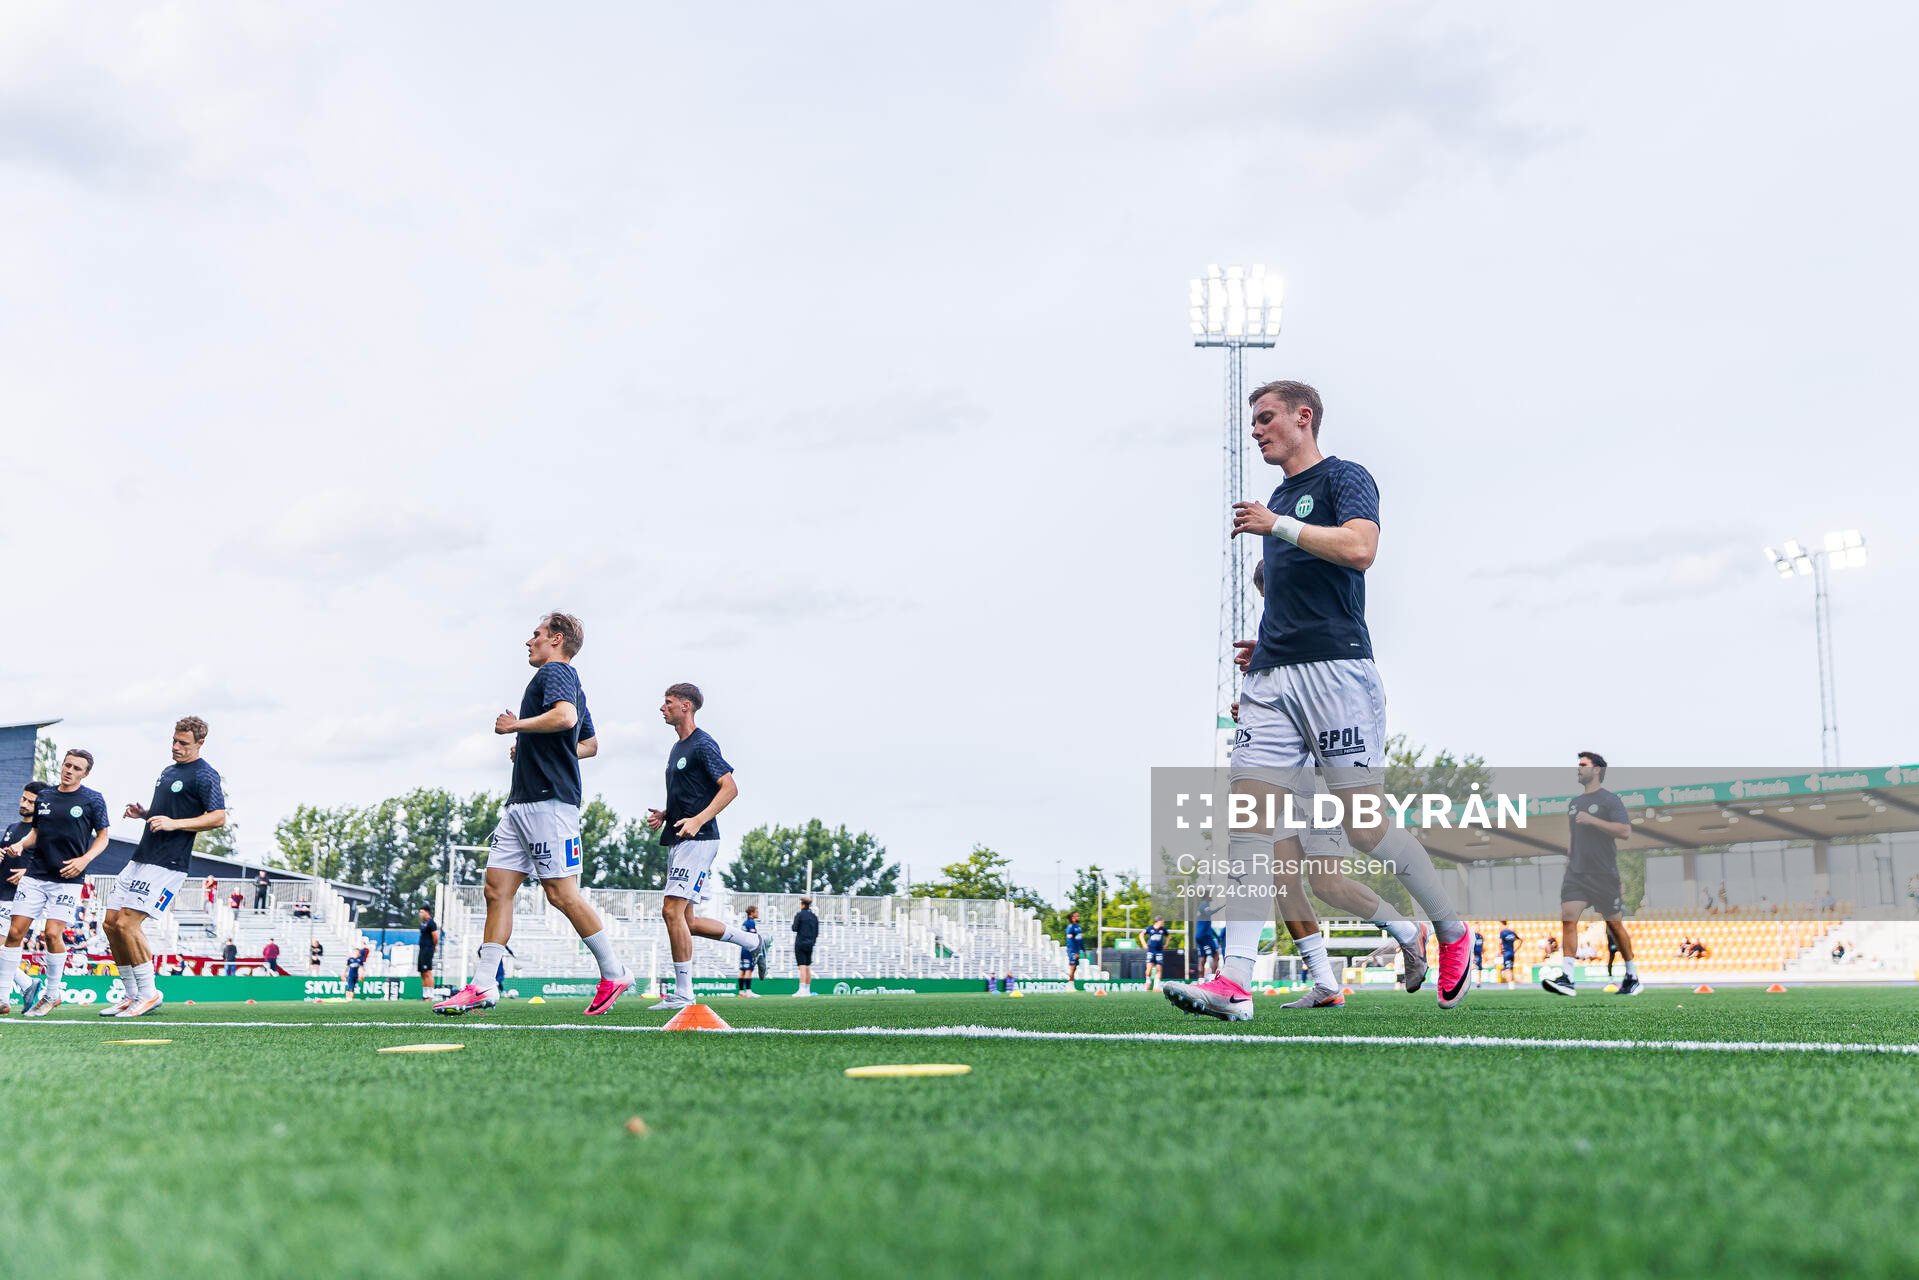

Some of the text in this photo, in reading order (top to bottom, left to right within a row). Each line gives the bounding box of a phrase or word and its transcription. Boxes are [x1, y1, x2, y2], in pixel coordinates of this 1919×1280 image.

[1318, 726, 1365, 751] SPOL
[528, 841, 551, 855] POL
[669, 867, 690, 879] SPOL
[129, 879, 151, 893] SPOL
[56, 894, 75, 905] SPO
[304, 980, 348, 995] SKYLT
[362, 981, 405, 995] NE
